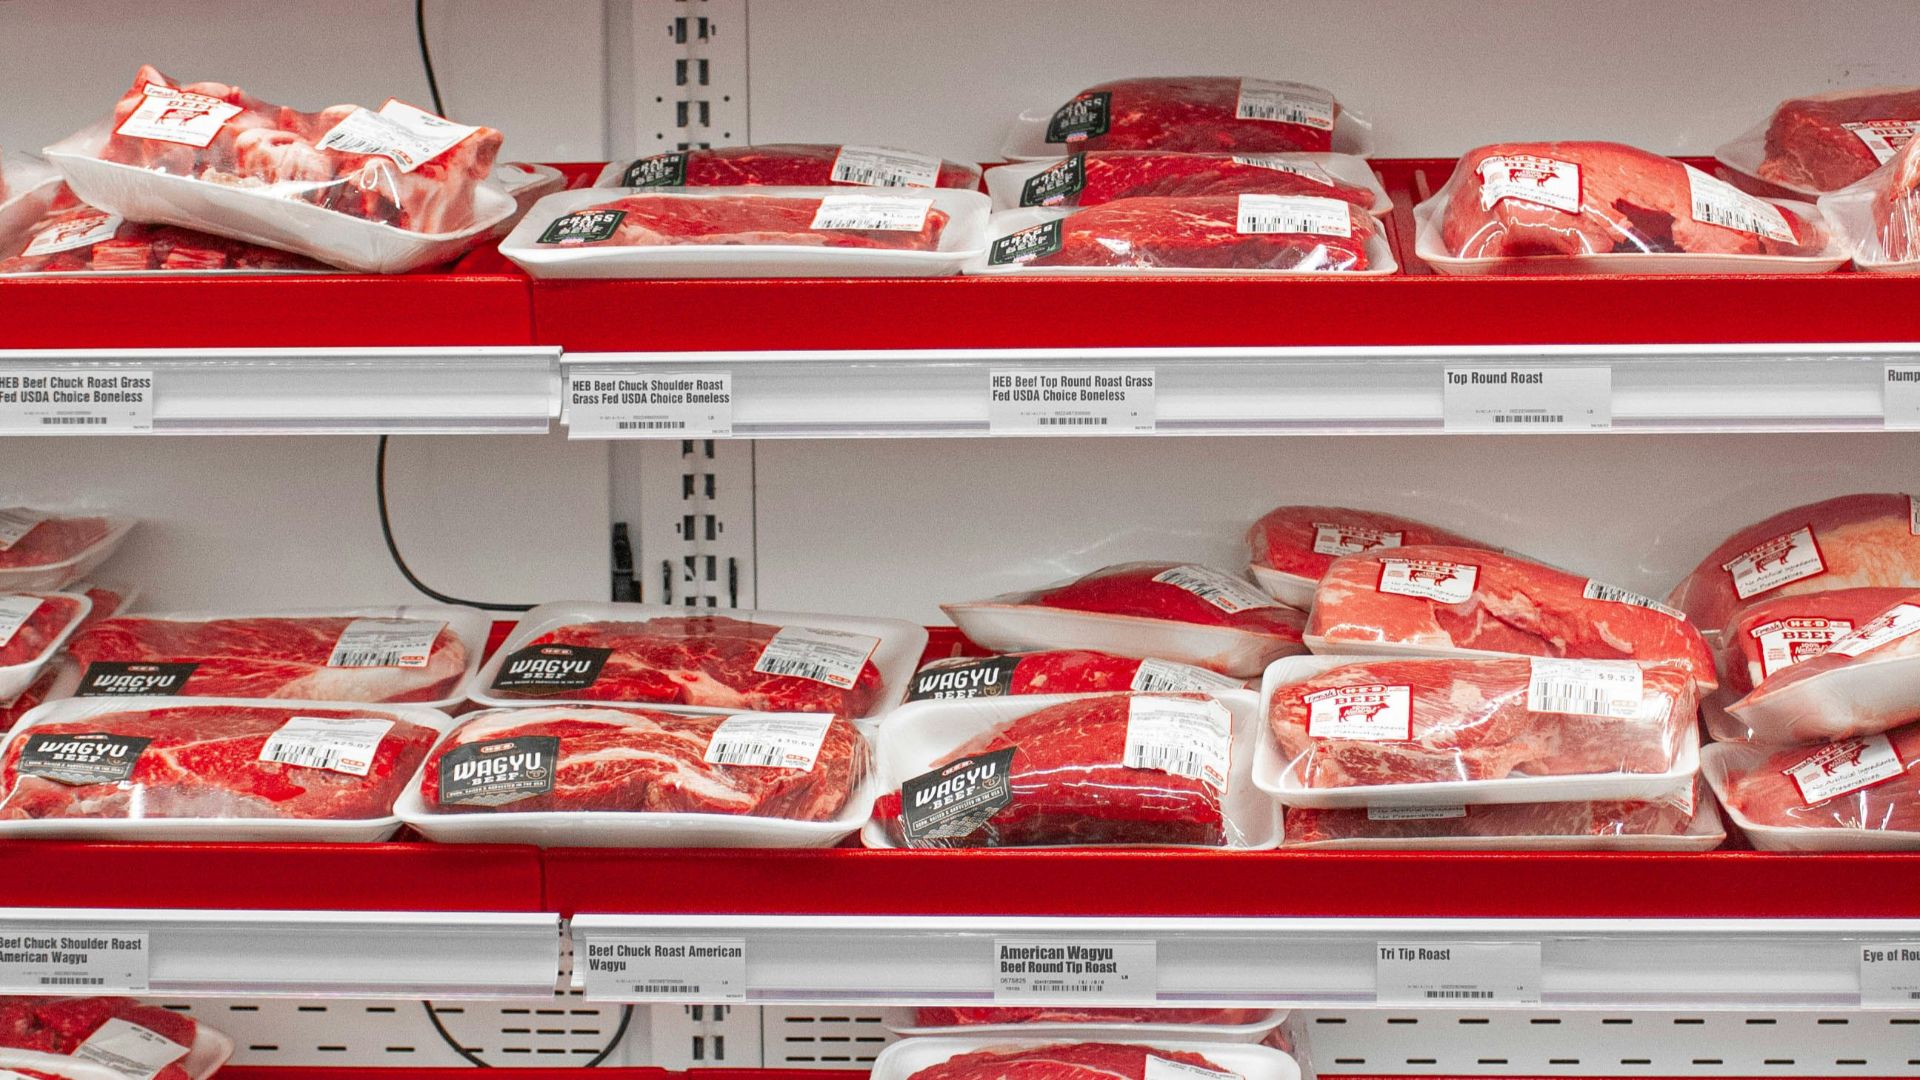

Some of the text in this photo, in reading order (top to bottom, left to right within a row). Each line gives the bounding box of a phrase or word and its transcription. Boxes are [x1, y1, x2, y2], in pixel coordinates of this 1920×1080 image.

[0, 377, 151, 388] HEB Beef Chuck Roast Grass
[992, 376, 1153, 388] HEB Beef Top Round Roast Grass
[1447, 372, 1543, 385] Top Round Roast
[572, 380, 723, 391] HEB Beef Chuck Shoulder Roast
[0, 391, 143, 402] Fed USDA Choice Boneless
[572, 393, 730, 404] Grass Fed USDA Choice Boneless
[992, 389, 1125, 401] Fed USDA Choice Boneless
[1782, 631, 1835, 640] BEEF
[509, 659, 591, 674] WAGYU
[93, 675, 176, 687] WAGYU
[919, 667, 1000, 693] WAGYU
[934, 688, 978, 700] BEEF
[37, 741, 129, 758] WAGYU
[52, 753, 101, 763] BEEF
[454, 752, 541, 781] WAGYU
[472, 772, 519, 786] BEEF
[915, 762, 996, 807] WAGYU
[932, 785, 976, 810] BEEF
[24, 937, 58, 949] Chuck
[60, 938, 108, 950] Shoulder
[111, 938, 142, 950] Roast
[589, 945, 742, 957] Beef Chuck Roast American
[1000, 945, 1113, 961] American Wagyu
[1380, 948, 1450, 961] Tri Tip Roast
[1864, 949, 1884, 963] Eye
[1887, 949, 1898, 961] of
[51, 951, 88, 965] Wagyu
[589, 959, 626, 972] Wagyu
[1000, 961, 1117, 974] Beef Round Tip Roast
